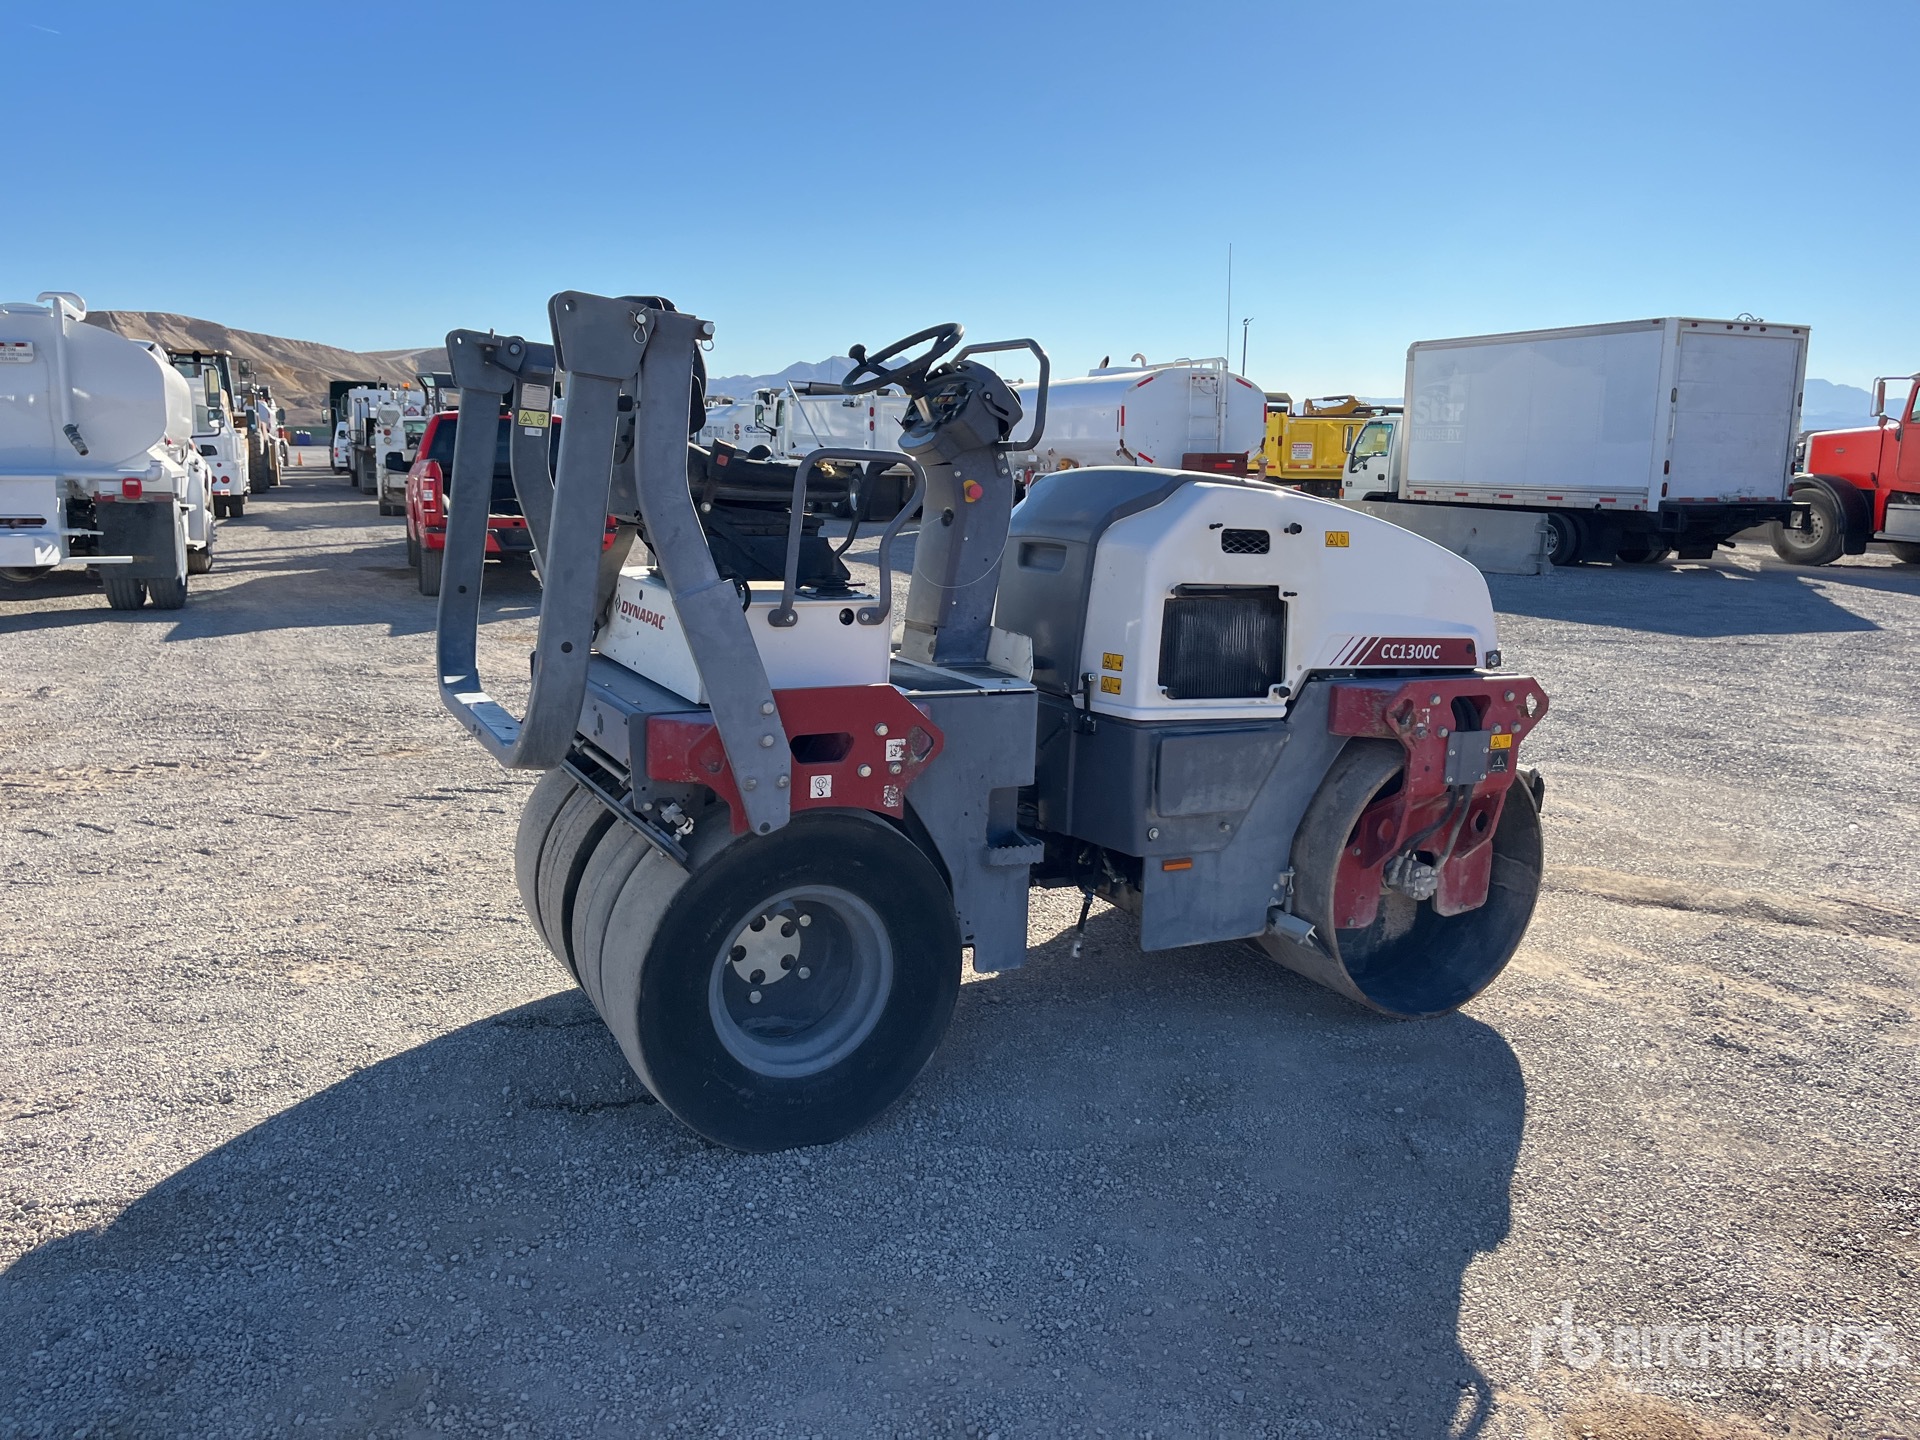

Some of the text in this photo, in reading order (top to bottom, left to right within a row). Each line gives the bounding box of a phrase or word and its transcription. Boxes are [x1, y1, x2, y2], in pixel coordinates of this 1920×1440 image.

[1414, 427, 1461, 441] NURSERY
[621, 600, 666, 631] DYNAPAC
[1380, 643, 1442, 660] CC1300C
